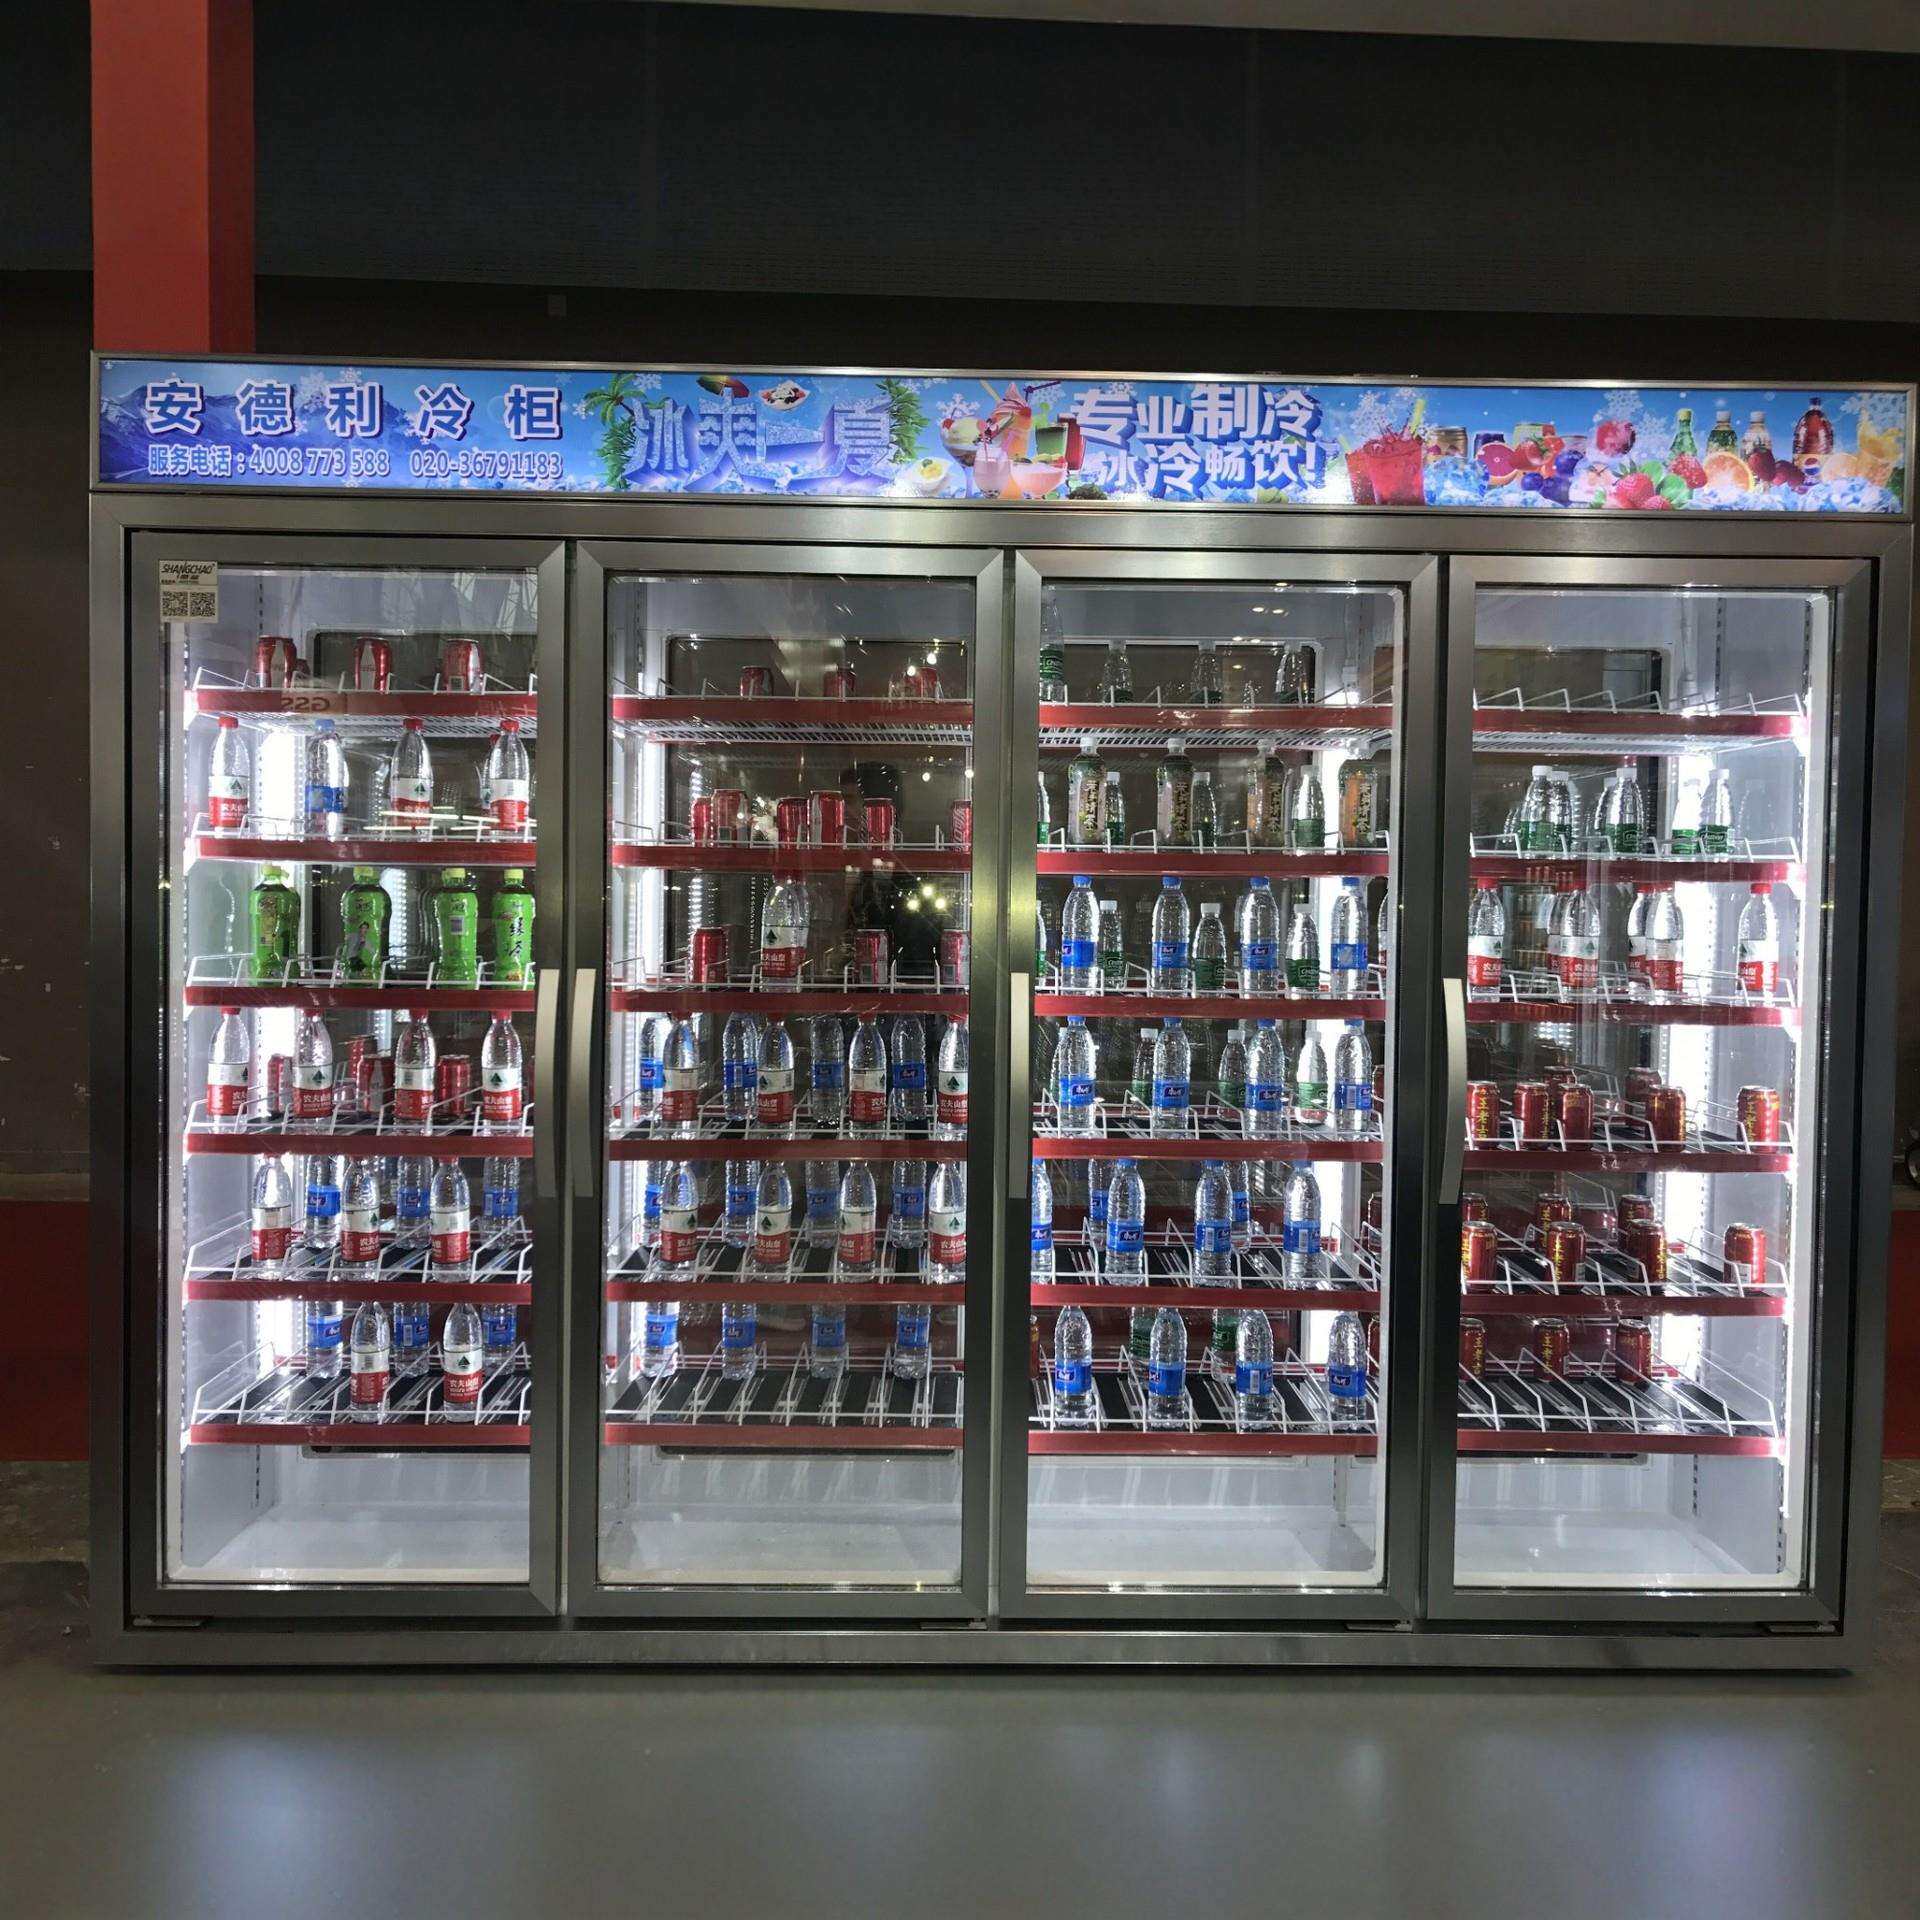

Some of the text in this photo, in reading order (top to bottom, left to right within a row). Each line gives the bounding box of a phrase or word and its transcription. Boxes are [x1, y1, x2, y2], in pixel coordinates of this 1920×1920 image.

[146, 378, 562, 440] 安德利冷柜
[622, 387, 904, 482] 冰爽一夏
[1070, 384, 1316, 445] 专业制冷
[410, 449, 563, 478] 020-36791183
